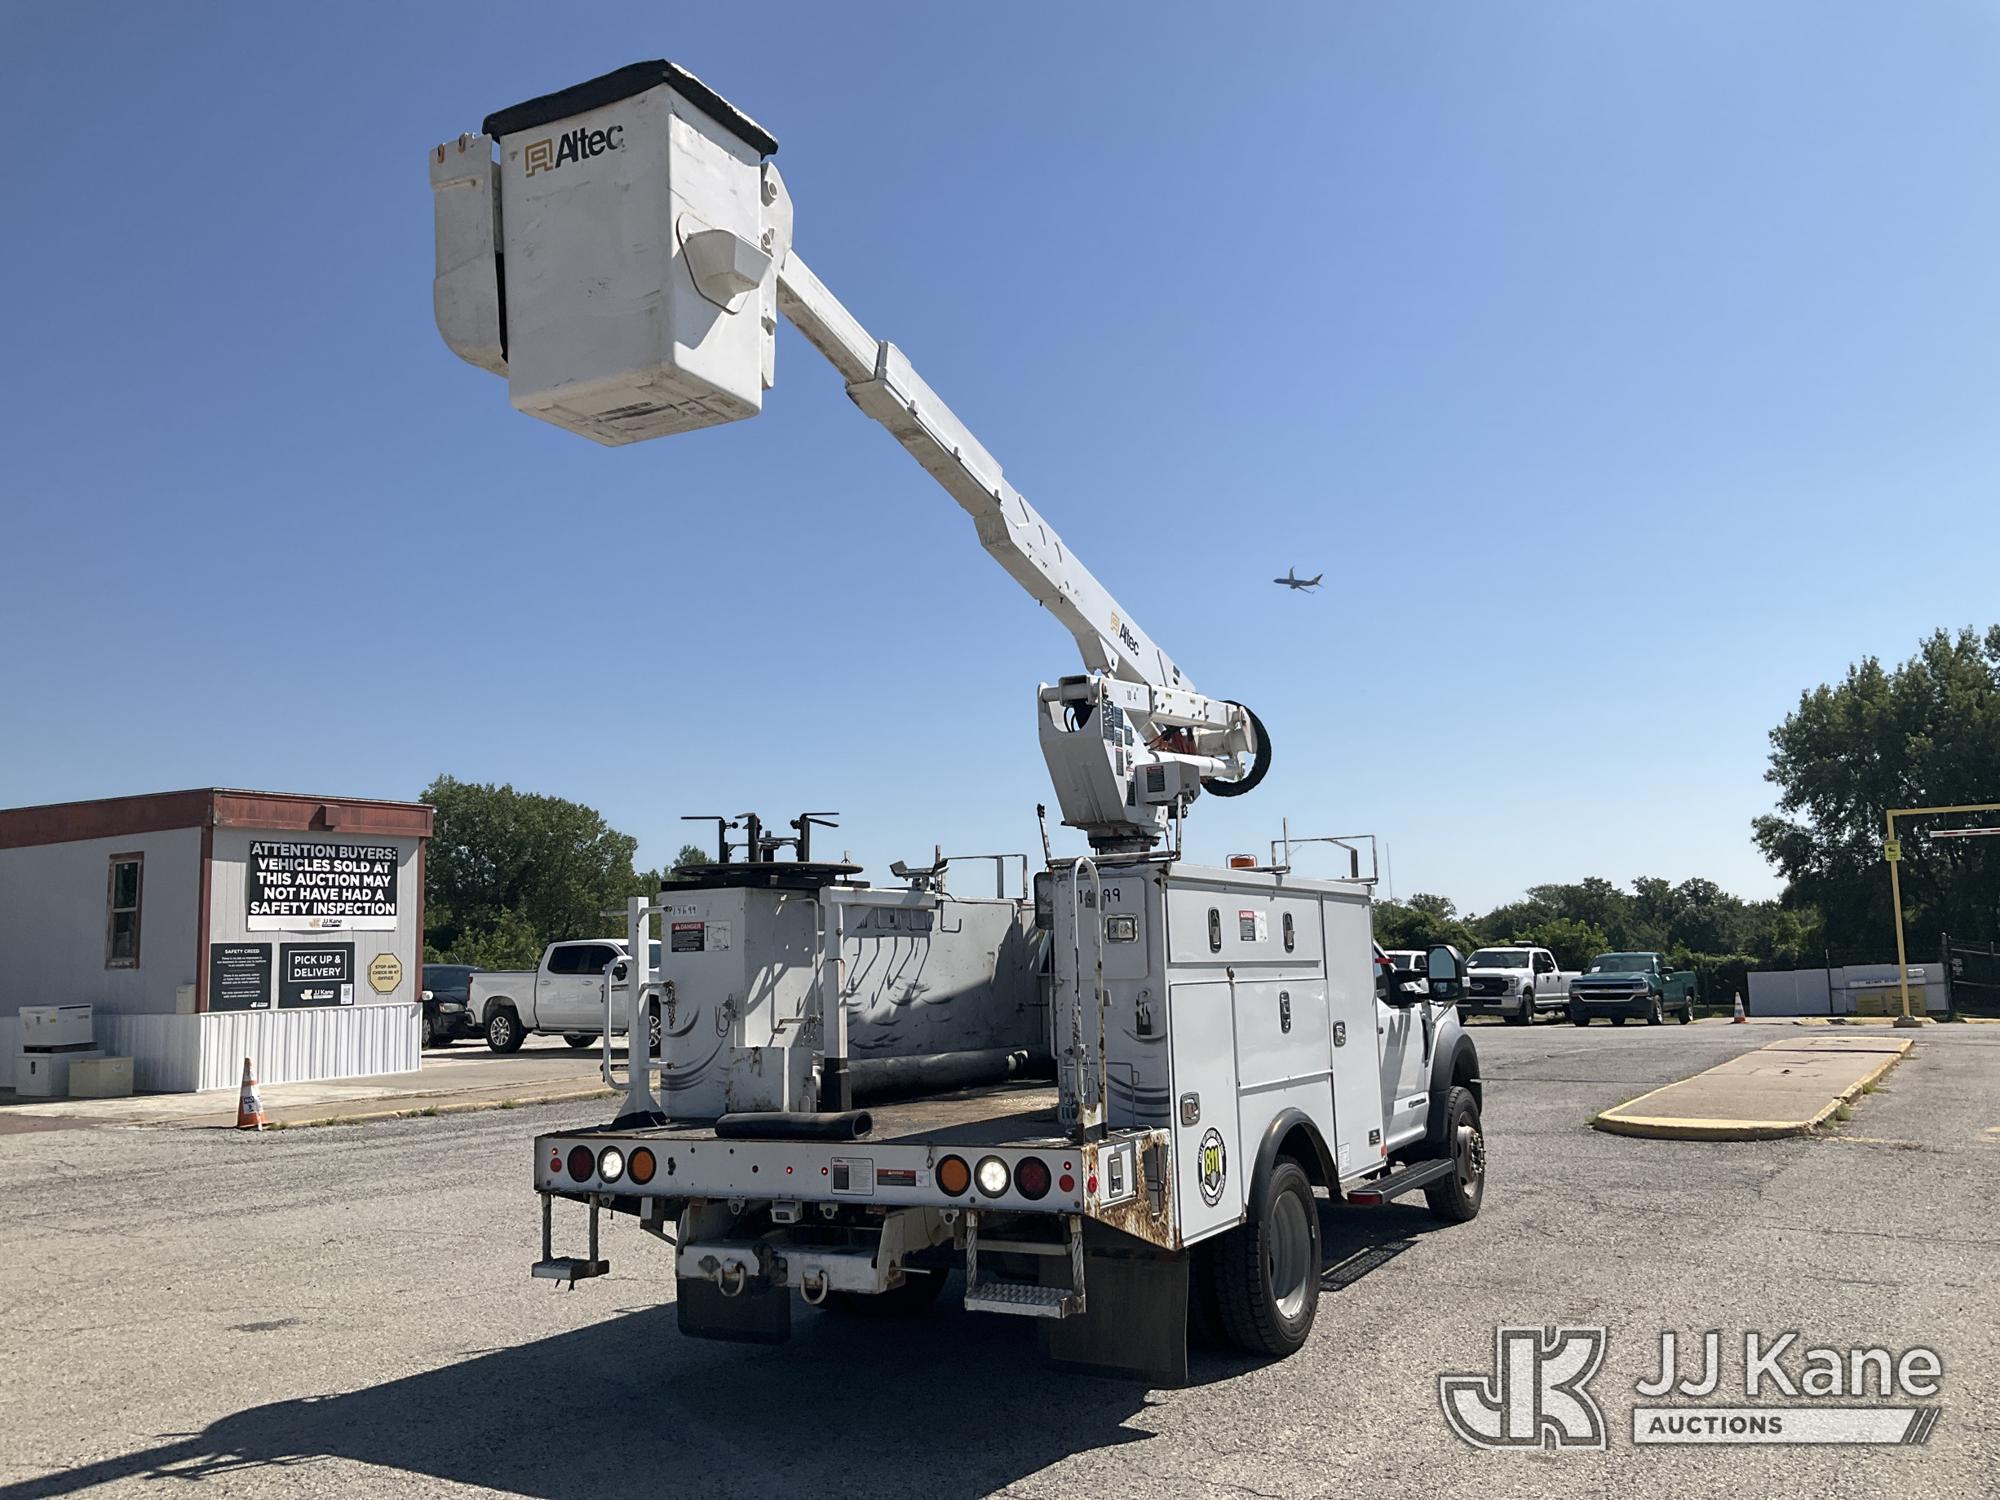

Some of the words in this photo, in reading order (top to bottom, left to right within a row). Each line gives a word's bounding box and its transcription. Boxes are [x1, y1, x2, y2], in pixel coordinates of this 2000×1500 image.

[555, 125, 624, 168] Altec
[1119, 623, 1139, 656] Altec
[251, 842, 336, 858] ATTENTION
[340, 846, 397, 860] BUYERS:
[258, 858, 330, 871] VEHICLES
[333, 860, 370, 873] SOLD
[373, 861, 391, 874] AT
[256, 872, 291, 885] THIS
[295, 873, 359, 887] AUCTION
[363, 875, 391, 887] MAY
[263, 887, 296, 900] NOT
[300, 887, 339, 900] HAVE
[342, 888, 372, 901] HAD
[374, 889, 385, 901] A
[250, 901, 310, 915] SAFETY
[313, 902, 396, 915] INSPECTION
[294, 955, 317, 965] PICK
[319, 955, 333, 964] UP
[334, 955, 341, 964] &
[294, 967, 341, 977] DELIVERY
[1204, 1146, 1220, 1176] 811
